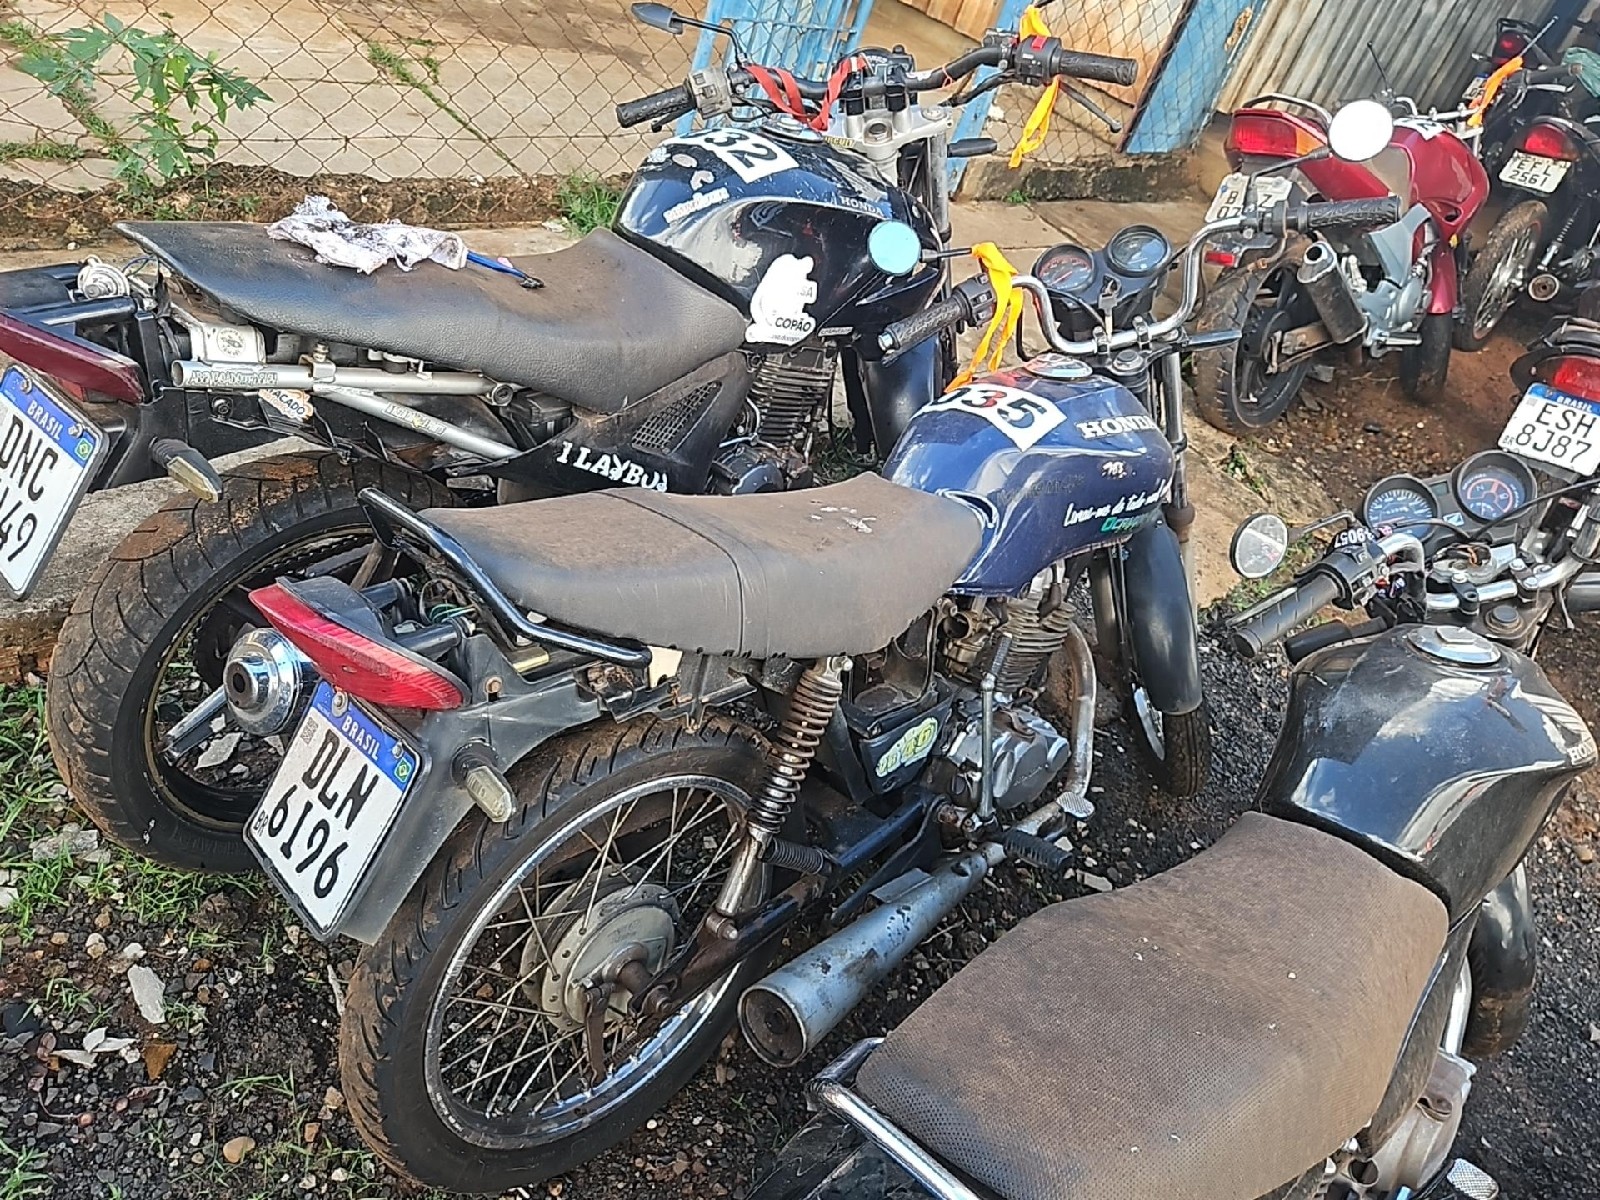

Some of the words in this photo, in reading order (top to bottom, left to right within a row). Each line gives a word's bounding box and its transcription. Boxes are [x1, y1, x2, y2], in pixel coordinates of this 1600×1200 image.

[1508, 169, 1548, 187] 2561
[1516, 159, 1551, 177] EFL
[840, 196, 885, 218] HONDA
[1225, 190, 1273, 208] BZ
[775, 317, 812, 333] COPÃO
[26, 400, 64, 441] BRASIL
[1535, 402, 1598, 438] ESH
[1556, 395, 1593, 413] BRASIL
[1078, 415, 1157, 439] HOND
[1516, 423, 1592, 463] 8J87
[0, 414, 59, 501] DNC
[0, 478, 38, 562] 49
[341, 715, 381, 762] BRASIL
[301, 728, 380, 830] DLN
[267, 784, 350, 899] 6196
